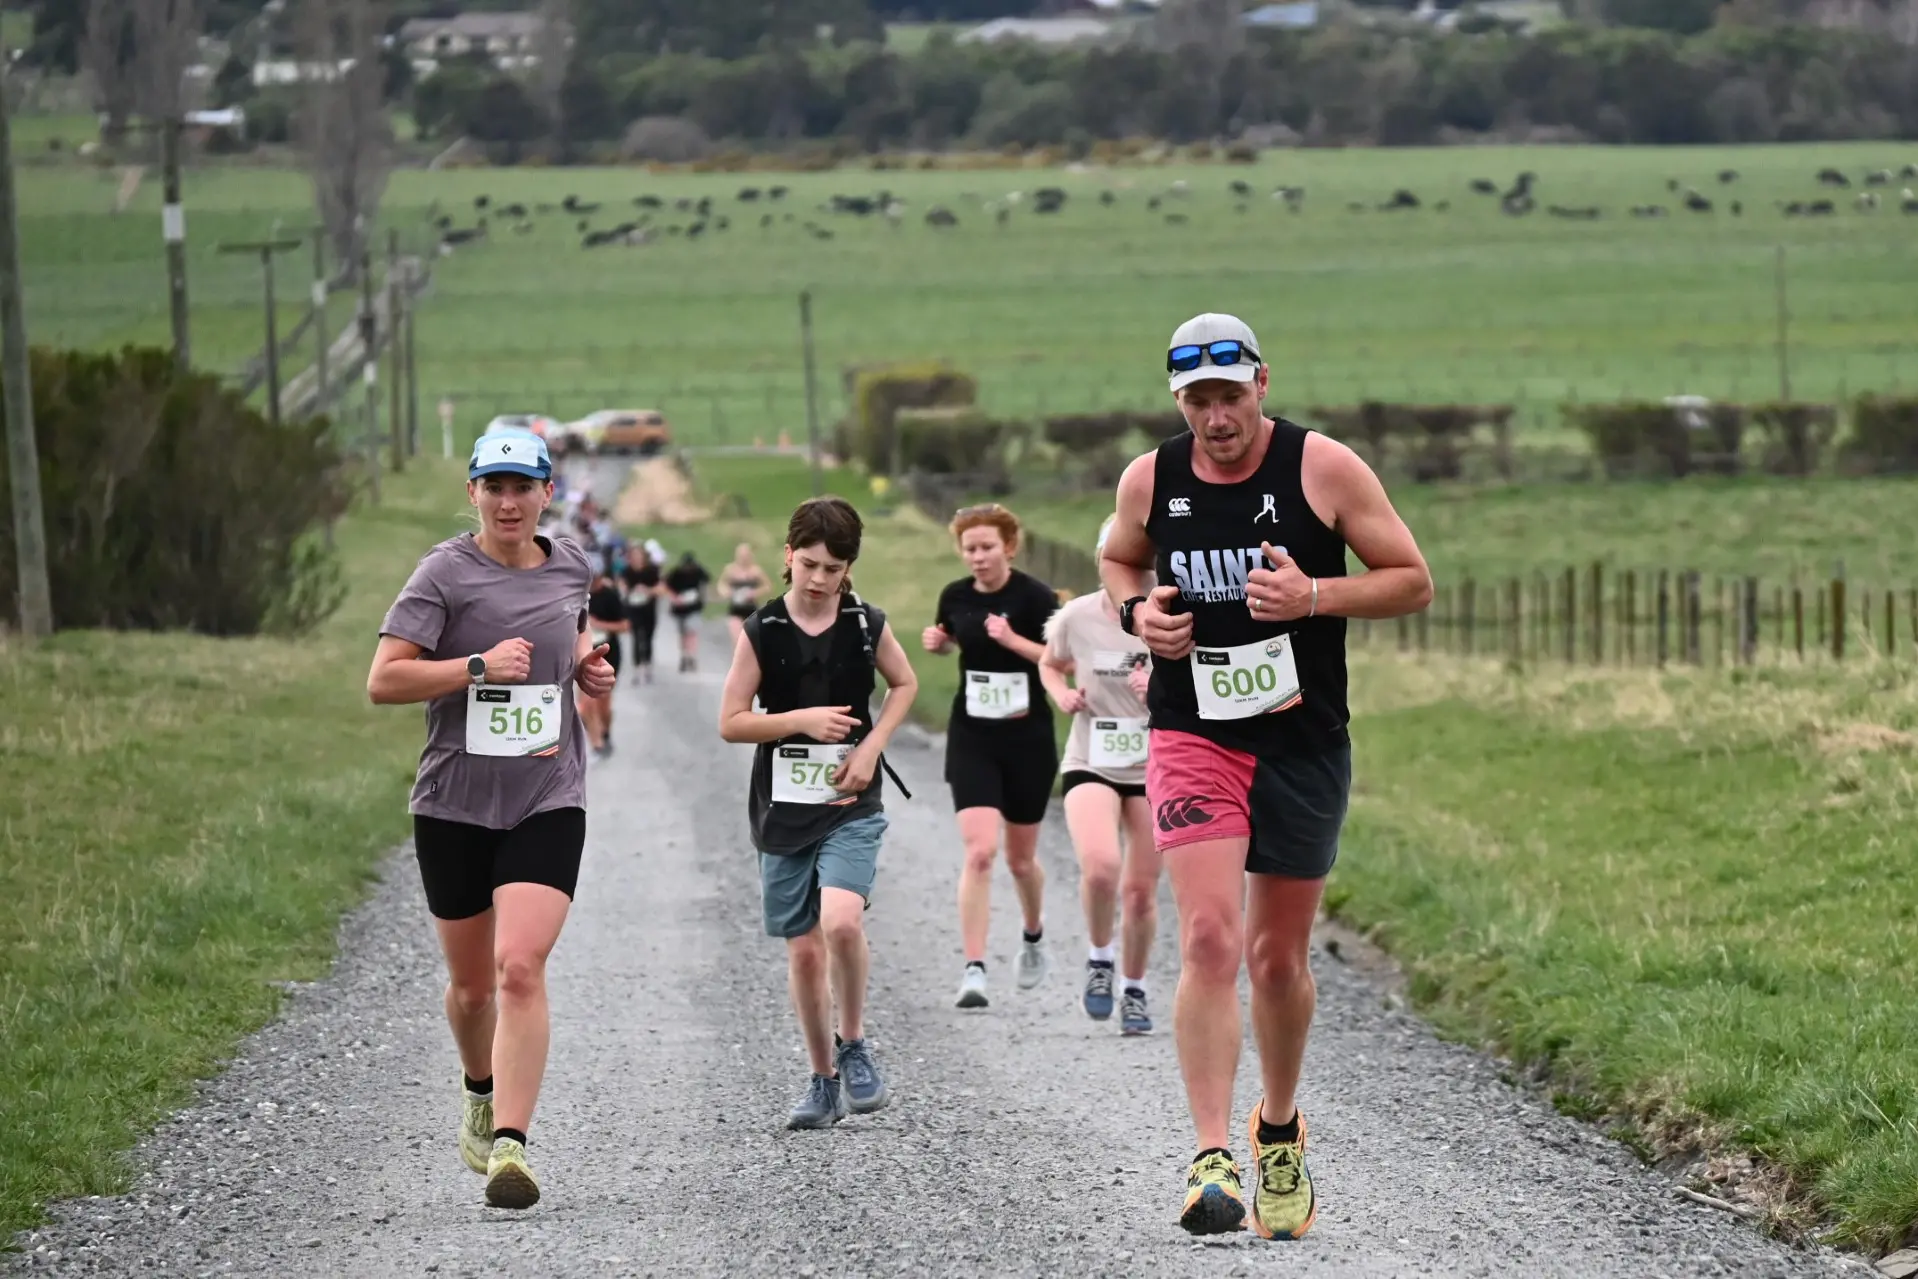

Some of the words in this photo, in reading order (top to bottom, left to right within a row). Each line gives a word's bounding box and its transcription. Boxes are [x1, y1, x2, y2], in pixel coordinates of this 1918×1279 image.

[1212, 663, 1276, 698] 600
[979, 686, 1010, 708] 611
[489, 706, 543, 735] 516
[1103, 732, 1143, 752] 593
